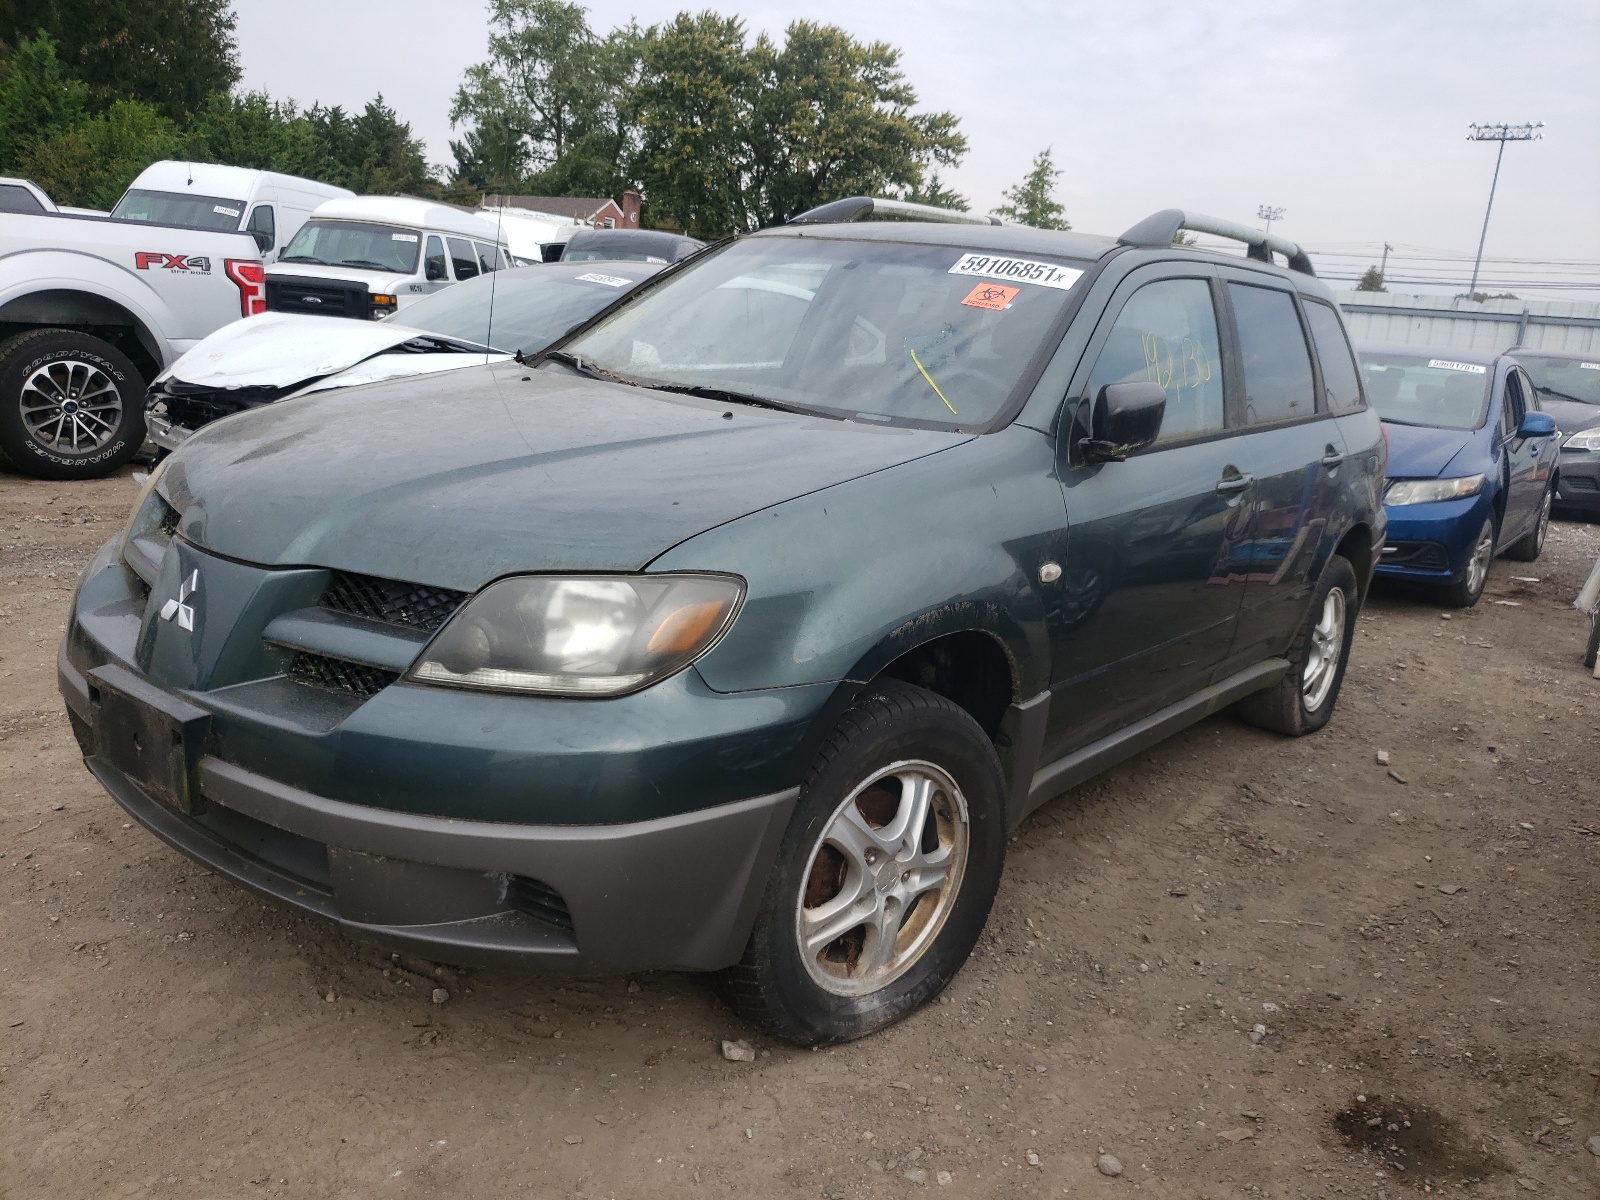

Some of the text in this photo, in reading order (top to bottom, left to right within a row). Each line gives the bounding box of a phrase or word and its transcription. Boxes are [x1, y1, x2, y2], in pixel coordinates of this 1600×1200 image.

[135, 251, 211, 271] FX4
[22, 350, 126, 381] GOODYEAR
[24, 439, 126, 466] WRANGLER
